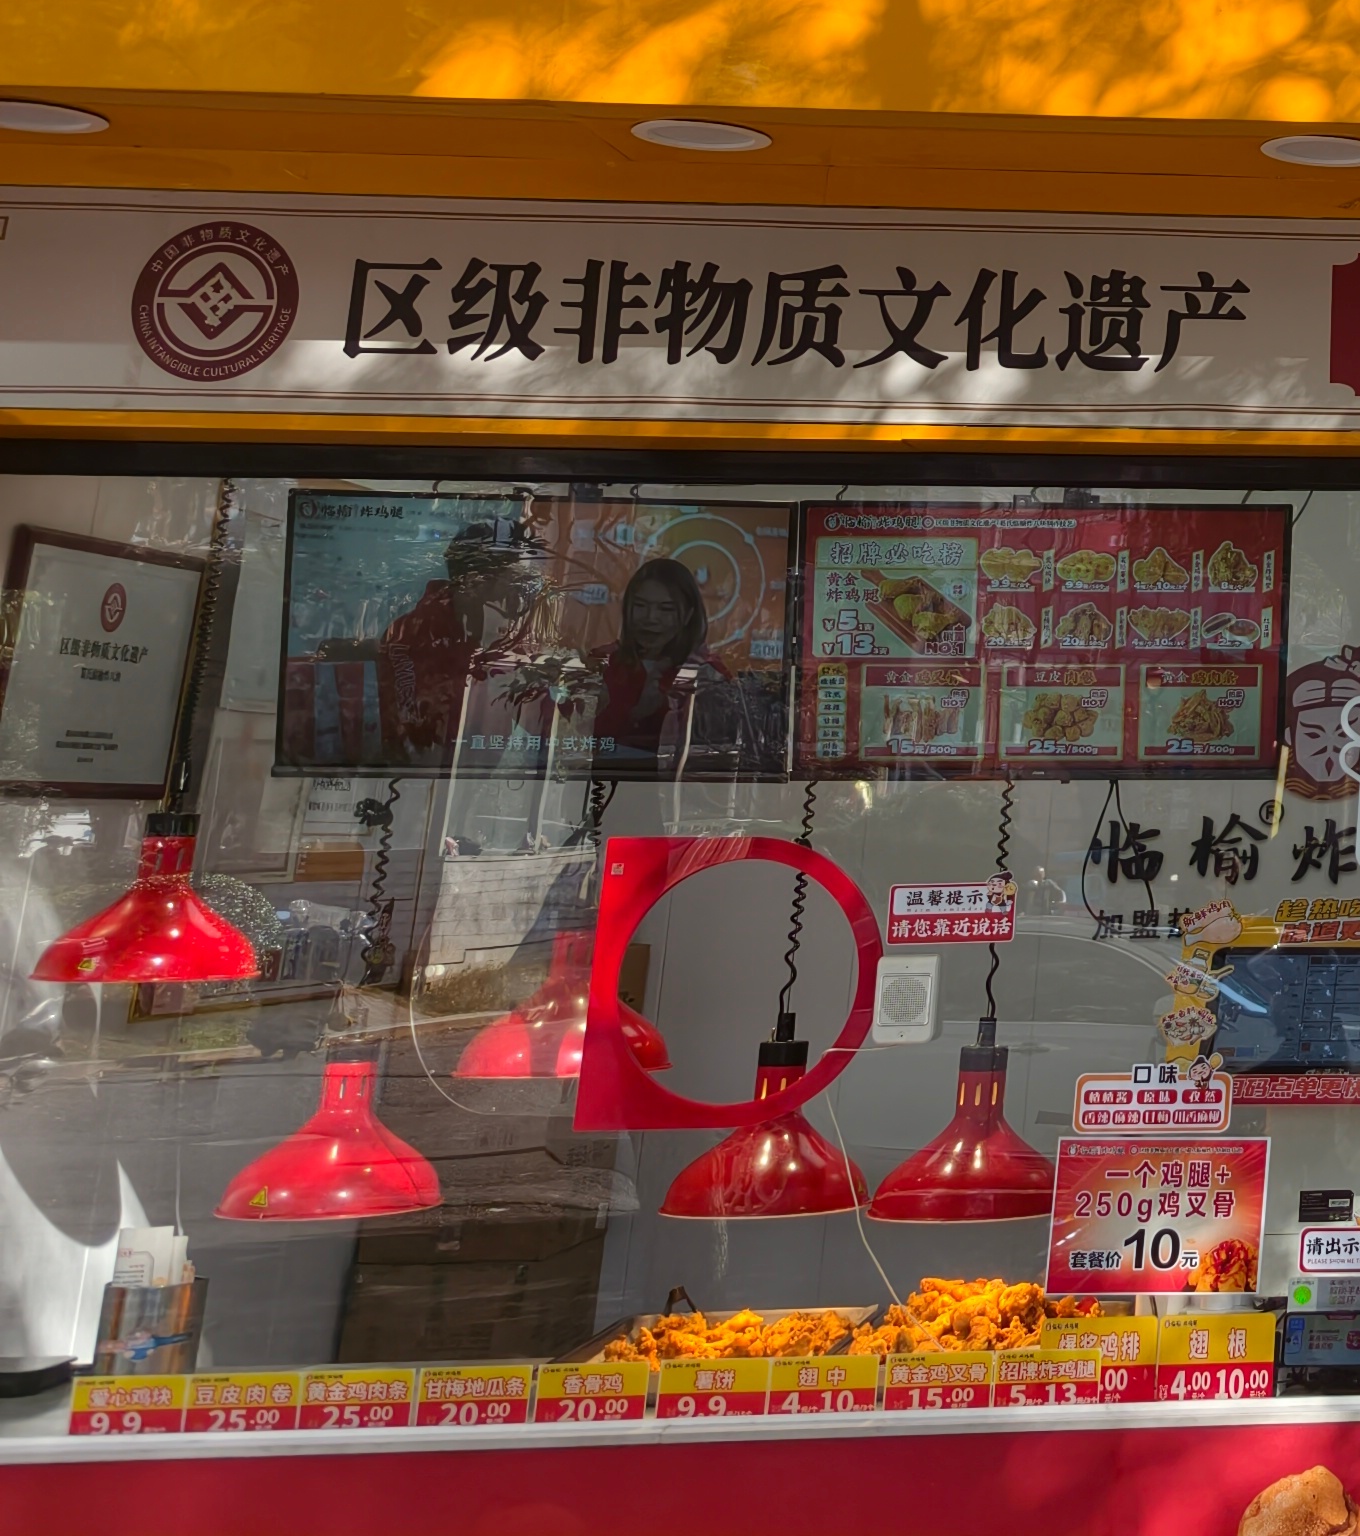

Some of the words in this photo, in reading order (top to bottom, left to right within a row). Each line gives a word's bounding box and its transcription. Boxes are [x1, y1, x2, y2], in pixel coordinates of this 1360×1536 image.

[339, 257, 1250, 373] 区级非物质文化遗产
[139, 304, 153, 339] CHINA
[146, 336, 200, 377] INTANGIBLE
[202, 354, 260, 377] CULTURAL
[257, 307, 292, 357] HERITAGE
[830, 542, 964, 566] 招牌必吃榜
[826, 572, 859, 587] 黄金
[826, 588, 880, 603] 炸鸡腿
[942, 699, 966, 707] HOT
[1082, 699, 1105, 707] HOT
[1219, 699, 1242, 707] HOT
[452, 734, 617, 753] 一直坚持用中式炸鸡
[906, 889, 984, 906] 温馨提示
[1181, 900, 1231, 927] 新鲜鸡肉
[892, 917, 1012, 938] 请您靠近说话
[1133, 1066, 1178, 1084] 口味
[1106, 1161, 1232, 1189] 一个鸡腿+
[1075, 1191, 1236, 1223] 250g鸡叉骨
[1058, 1331, 1140, 1362] 爆浆鸡排
[1188, 1327, 1248, 1360] 翅根
[694, 1369, 736, 1391] 薯饼
[798, 1366, 846, 1387] 翅中
[890, 1363, 988, 1384] 黄金鸡叉骨
[999, 1359, 1096, 1382] 招牌炸鸡腿
[194, 1383, 293, 1406] 豆皮肉卷
[306, 1381, 410, 1403] 黄金鸡肉条
[425, 1376, 526, 1400] 甘梅地瓜条
[563, 1373, 625, 1395] 香骨鸡
[1170, 1369, 1211, 1401] 4.00
[1215, 1369, 1269, 1400] 10.00
[89, 1386, 173, 1408] 爱心鸡块
[676, 1394, 727, 1418] 9.9
[907, 1386, 975, 1410] 15.00
[207, 1409, 280, 1432] 25.00
[321, 1405, 394, 1431] 25.00
[439, 1401, 511, 1426] 20.00
[558, 1397, 629, 1423] 20.00
[89, 1410, 142, 1435] 9.9
